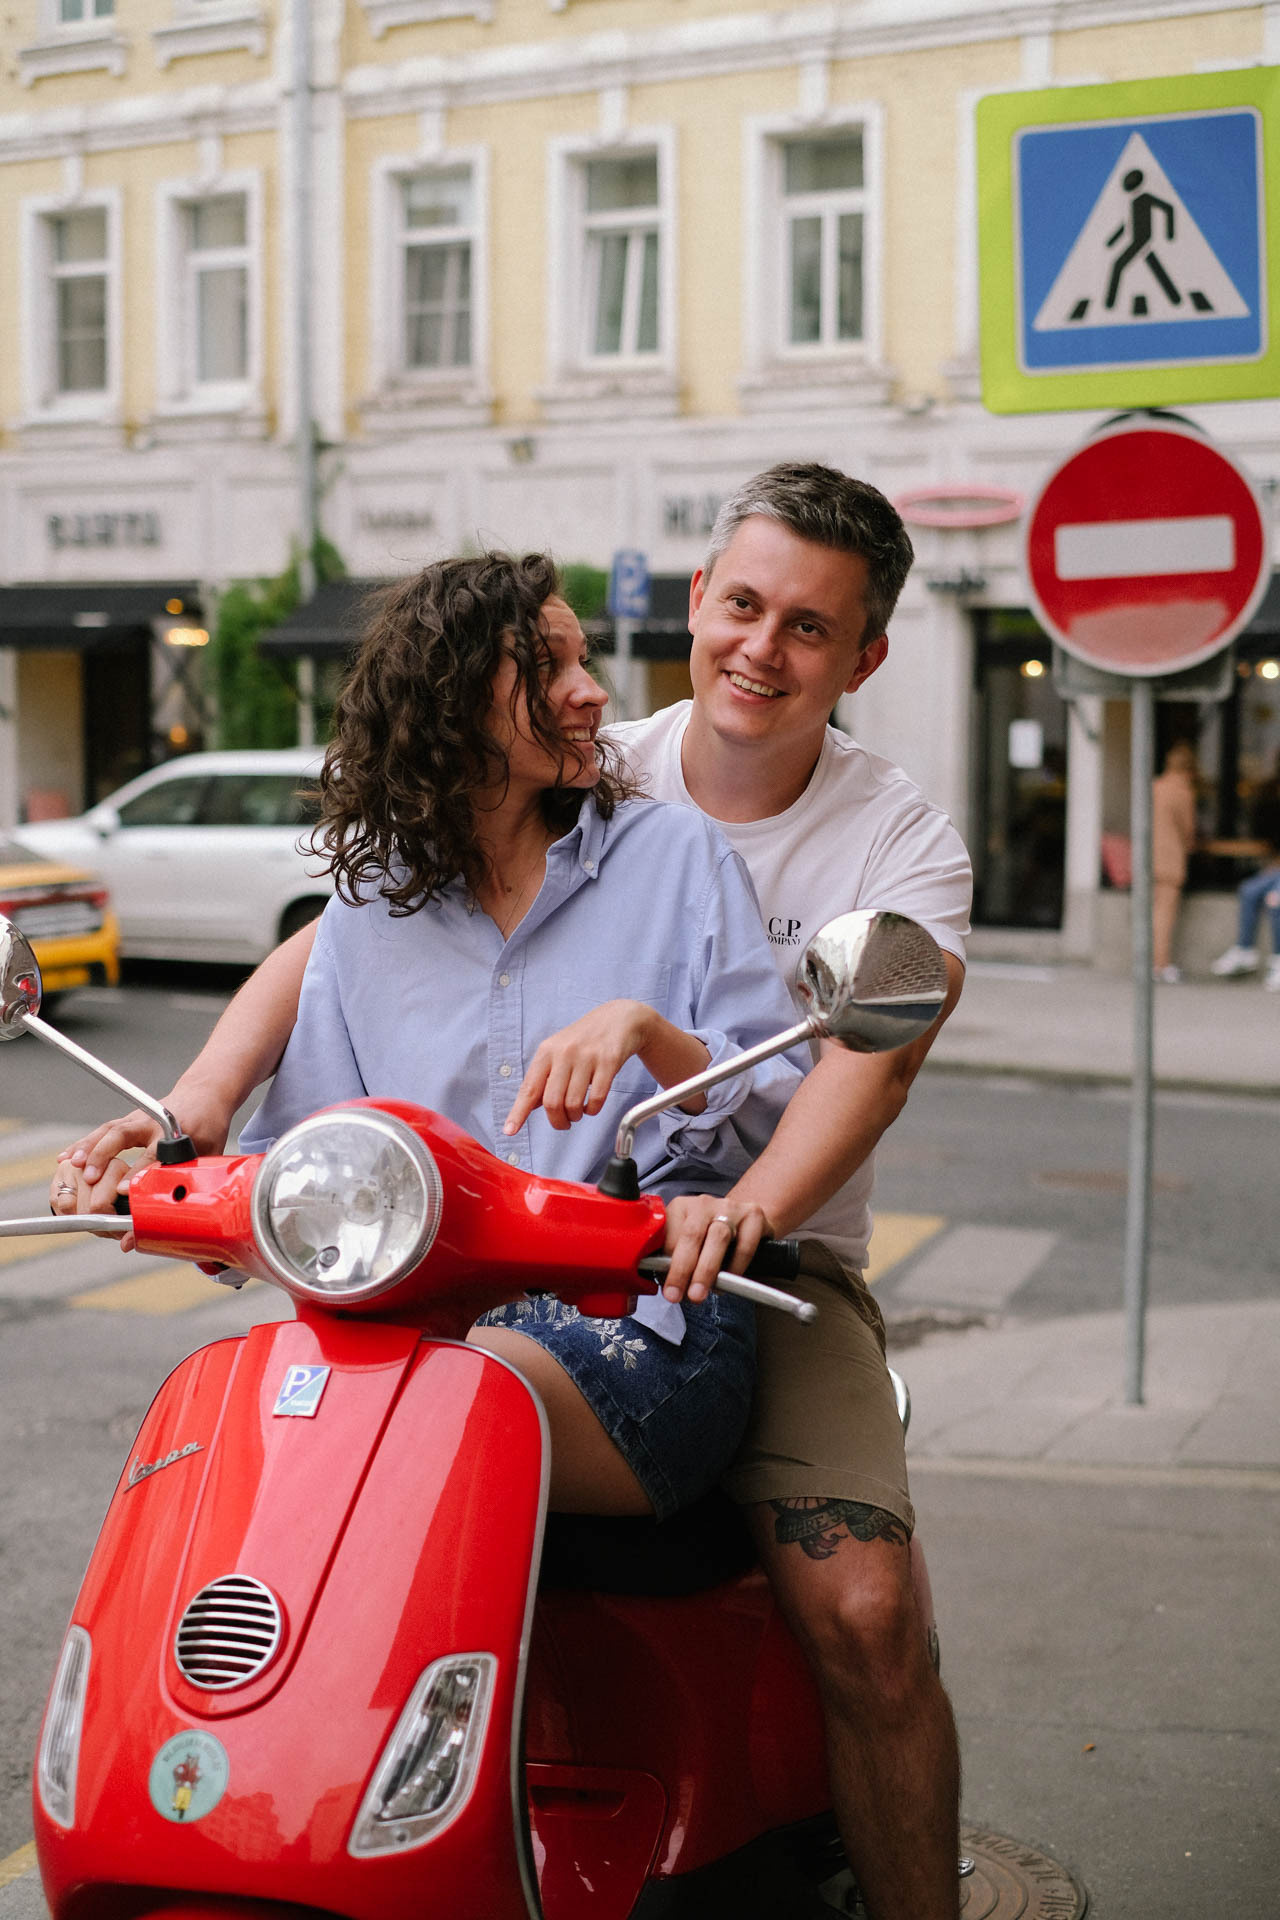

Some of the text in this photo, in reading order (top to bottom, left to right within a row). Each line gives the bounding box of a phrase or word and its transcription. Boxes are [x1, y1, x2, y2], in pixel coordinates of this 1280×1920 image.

[768, 916, 802, 938] C.P.
[767, 935, 801, 946] OMPANY
[283, 1367, 312, 1397] P
[124, 1441, 205, 1494] Vespa
